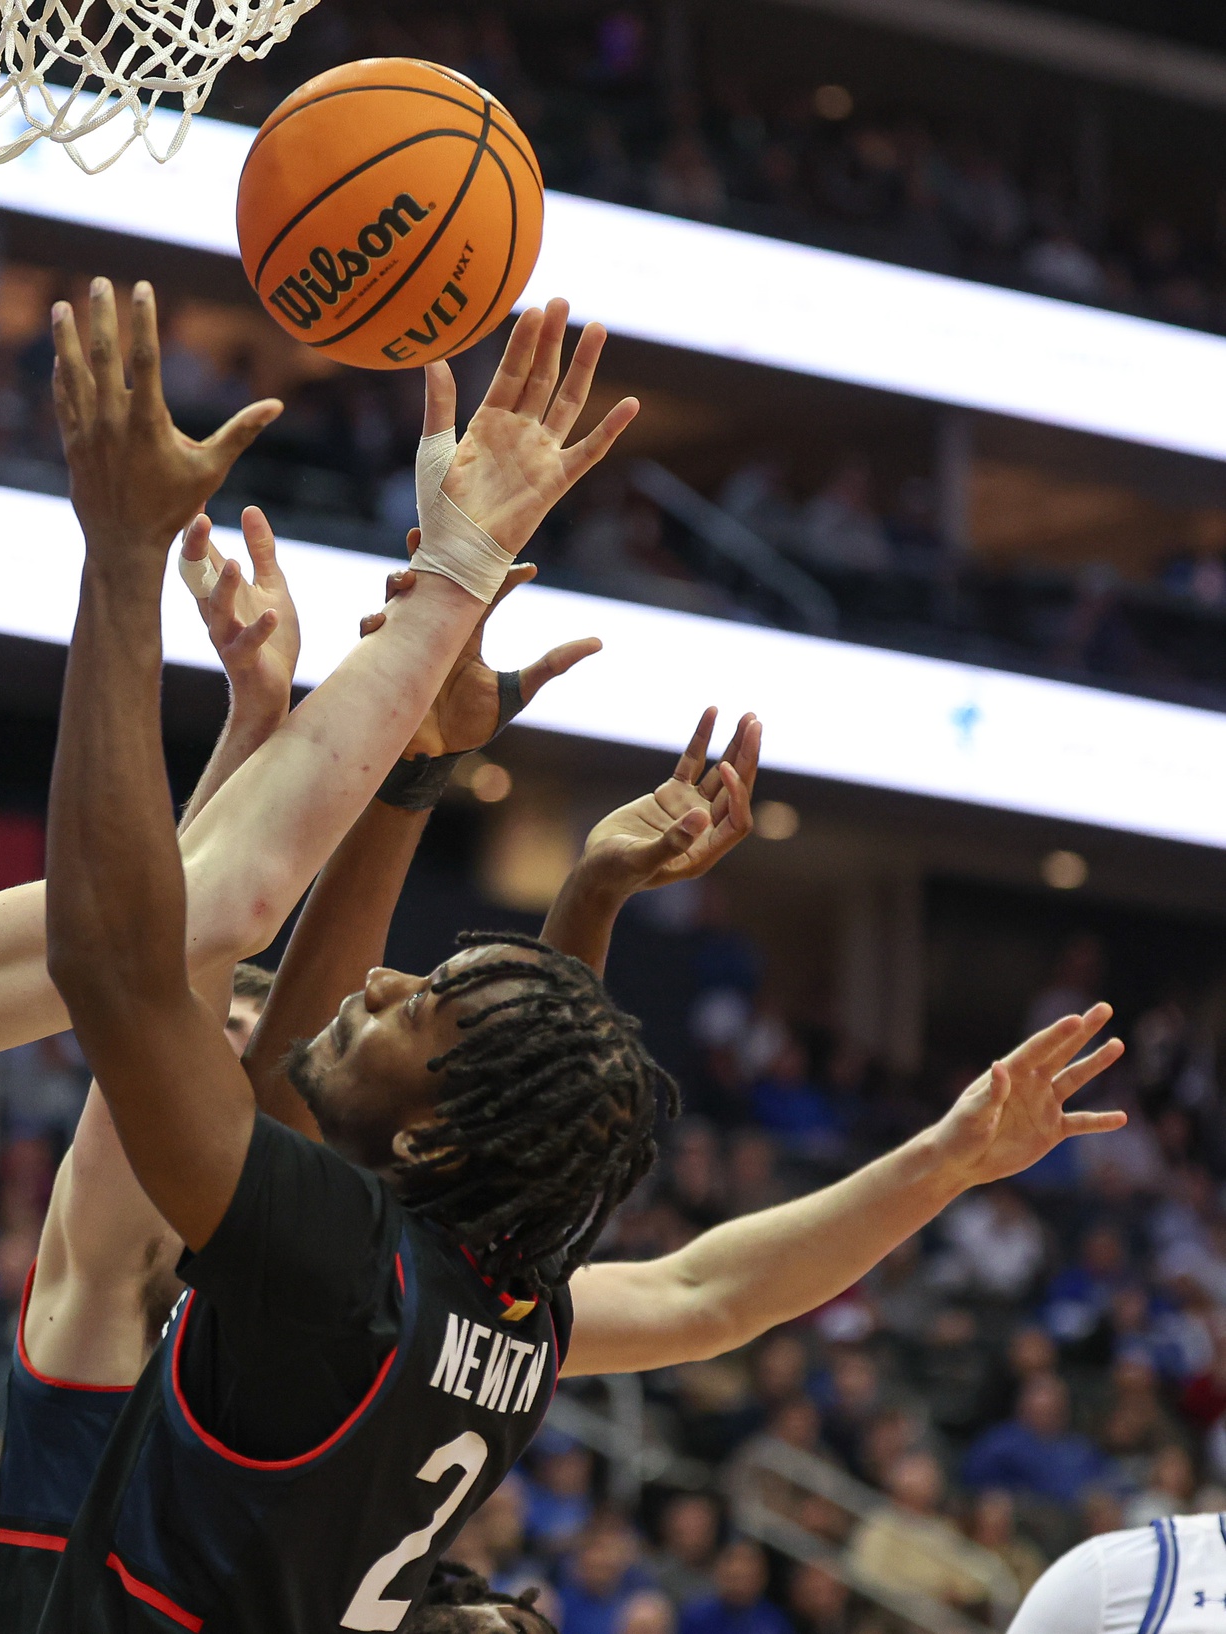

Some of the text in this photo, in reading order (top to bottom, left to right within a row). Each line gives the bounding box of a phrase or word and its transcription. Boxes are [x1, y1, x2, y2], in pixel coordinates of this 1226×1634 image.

[268, 192, 429, 329] Wilson
[380, 240, 474, 362] EVO NXT
[339, 1431, 488, 1631] 2
